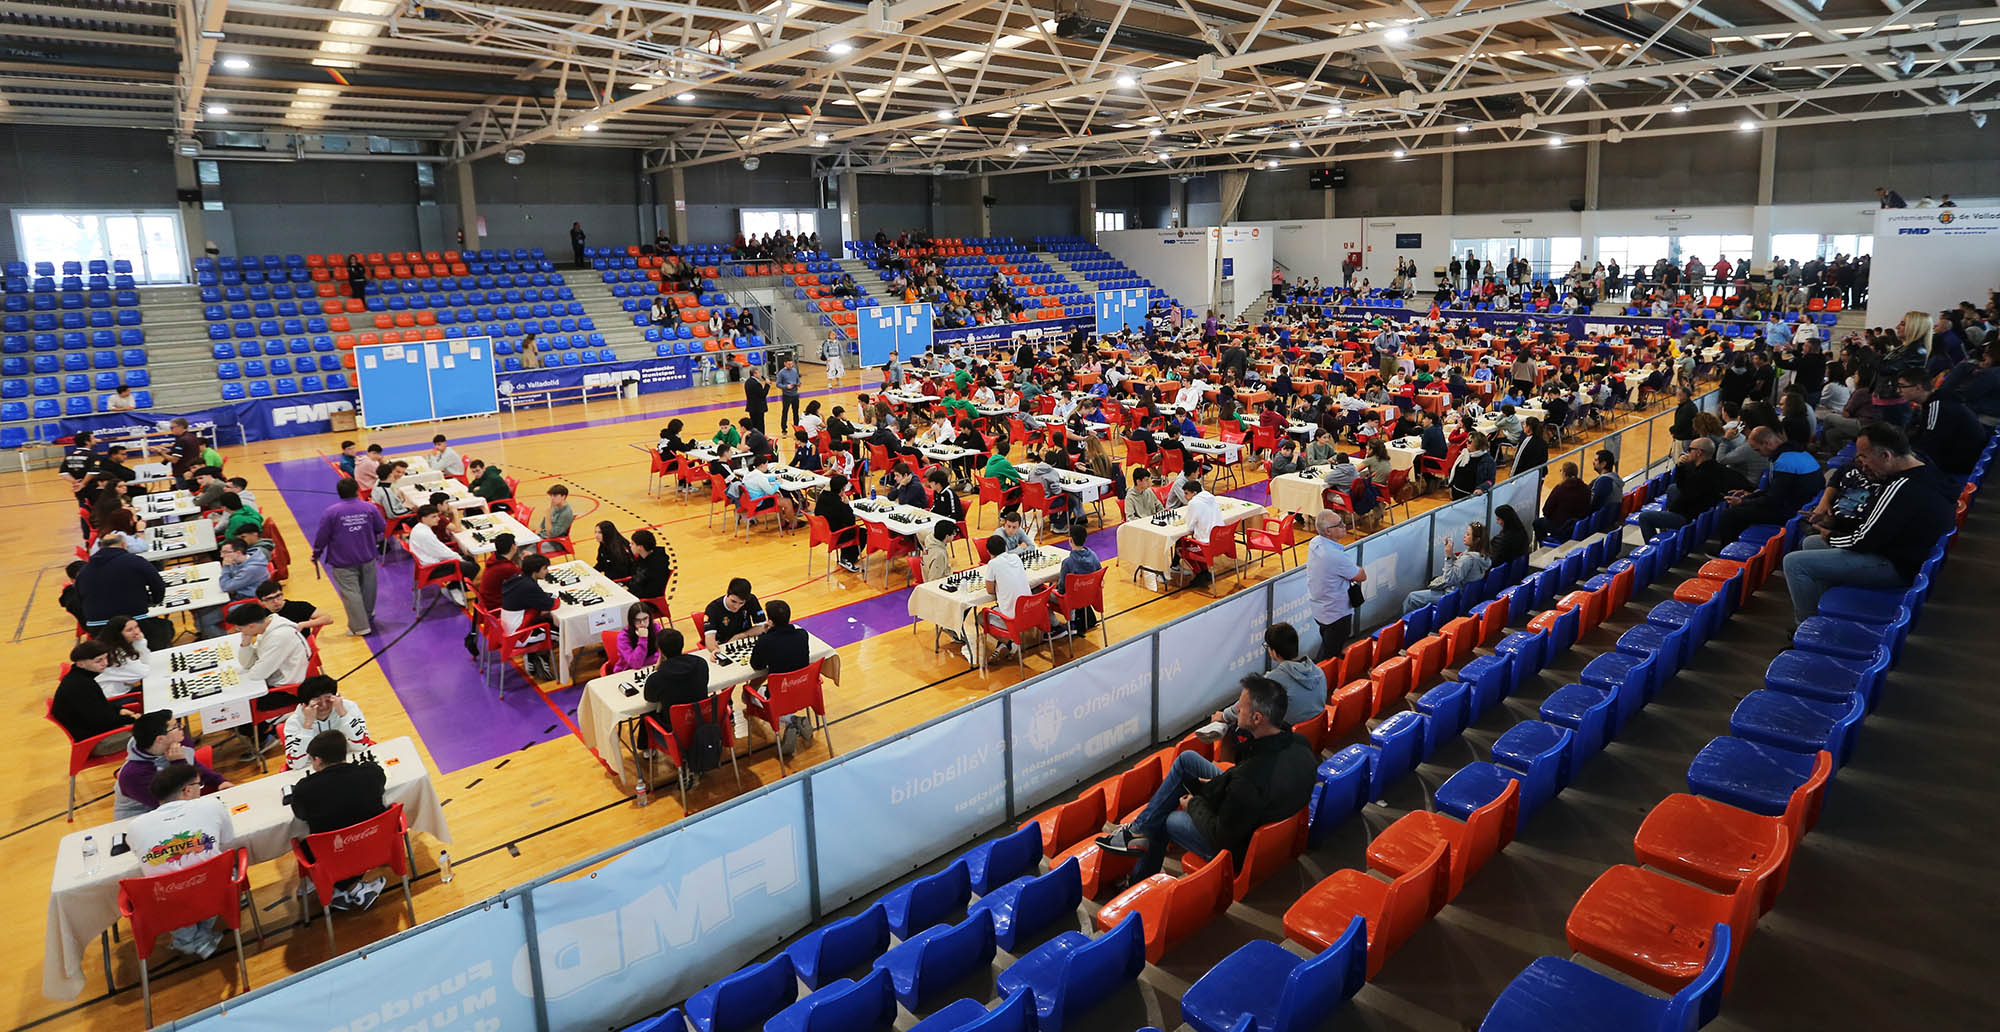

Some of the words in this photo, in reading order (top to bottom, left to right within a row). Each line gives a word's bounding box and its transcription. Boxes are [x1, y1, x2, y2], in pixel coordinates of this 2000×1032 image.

[641, 365, 675, 374] Fundación
[641, 370, 675, 378] Municipal
[526, 379, 560, 388] Valladolid
[141, 840, 194, 864] CREATIVE
